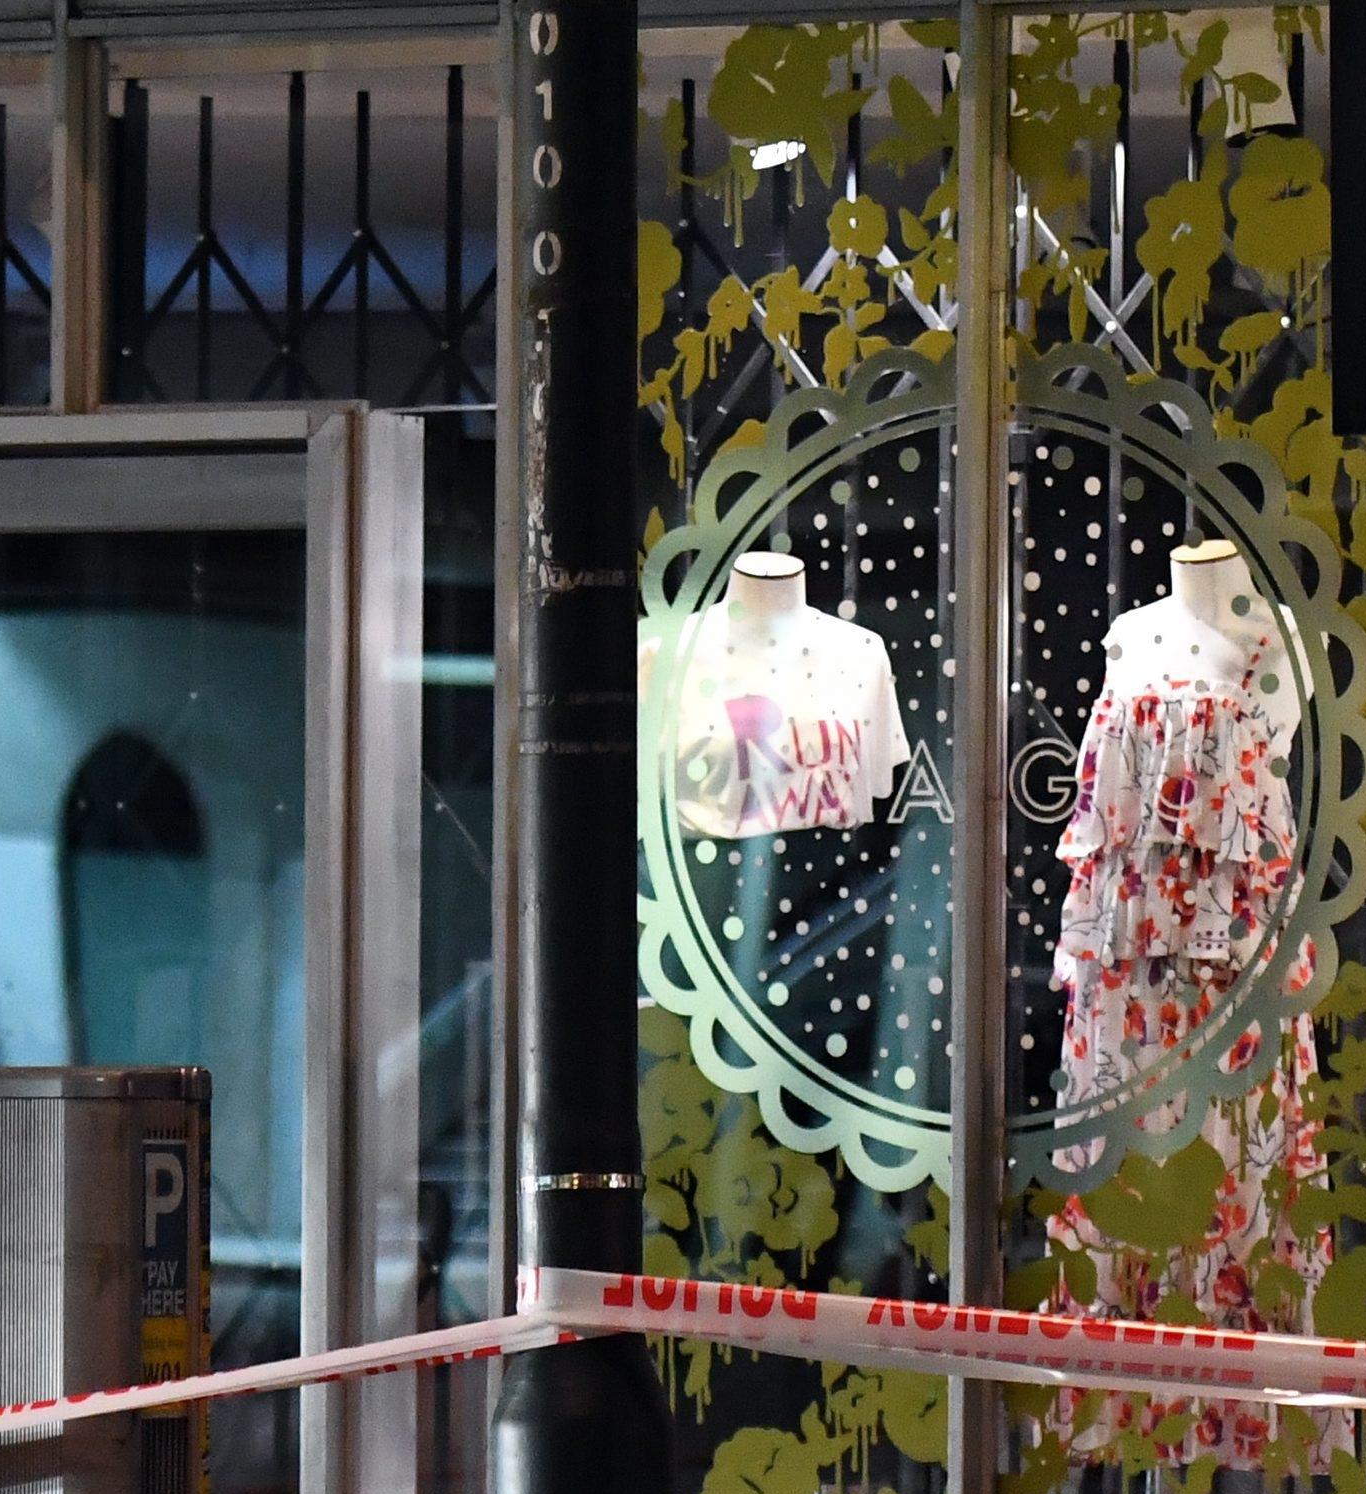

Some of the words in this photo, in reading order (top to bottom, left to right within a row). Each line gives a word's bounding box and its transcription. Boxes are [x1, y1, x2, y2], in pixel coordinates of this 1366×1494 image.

[144, 1152, 184, 1248] P
[147, 1260, 178, 1288] PAY
[143, 1290, 185, 1316] HERE
